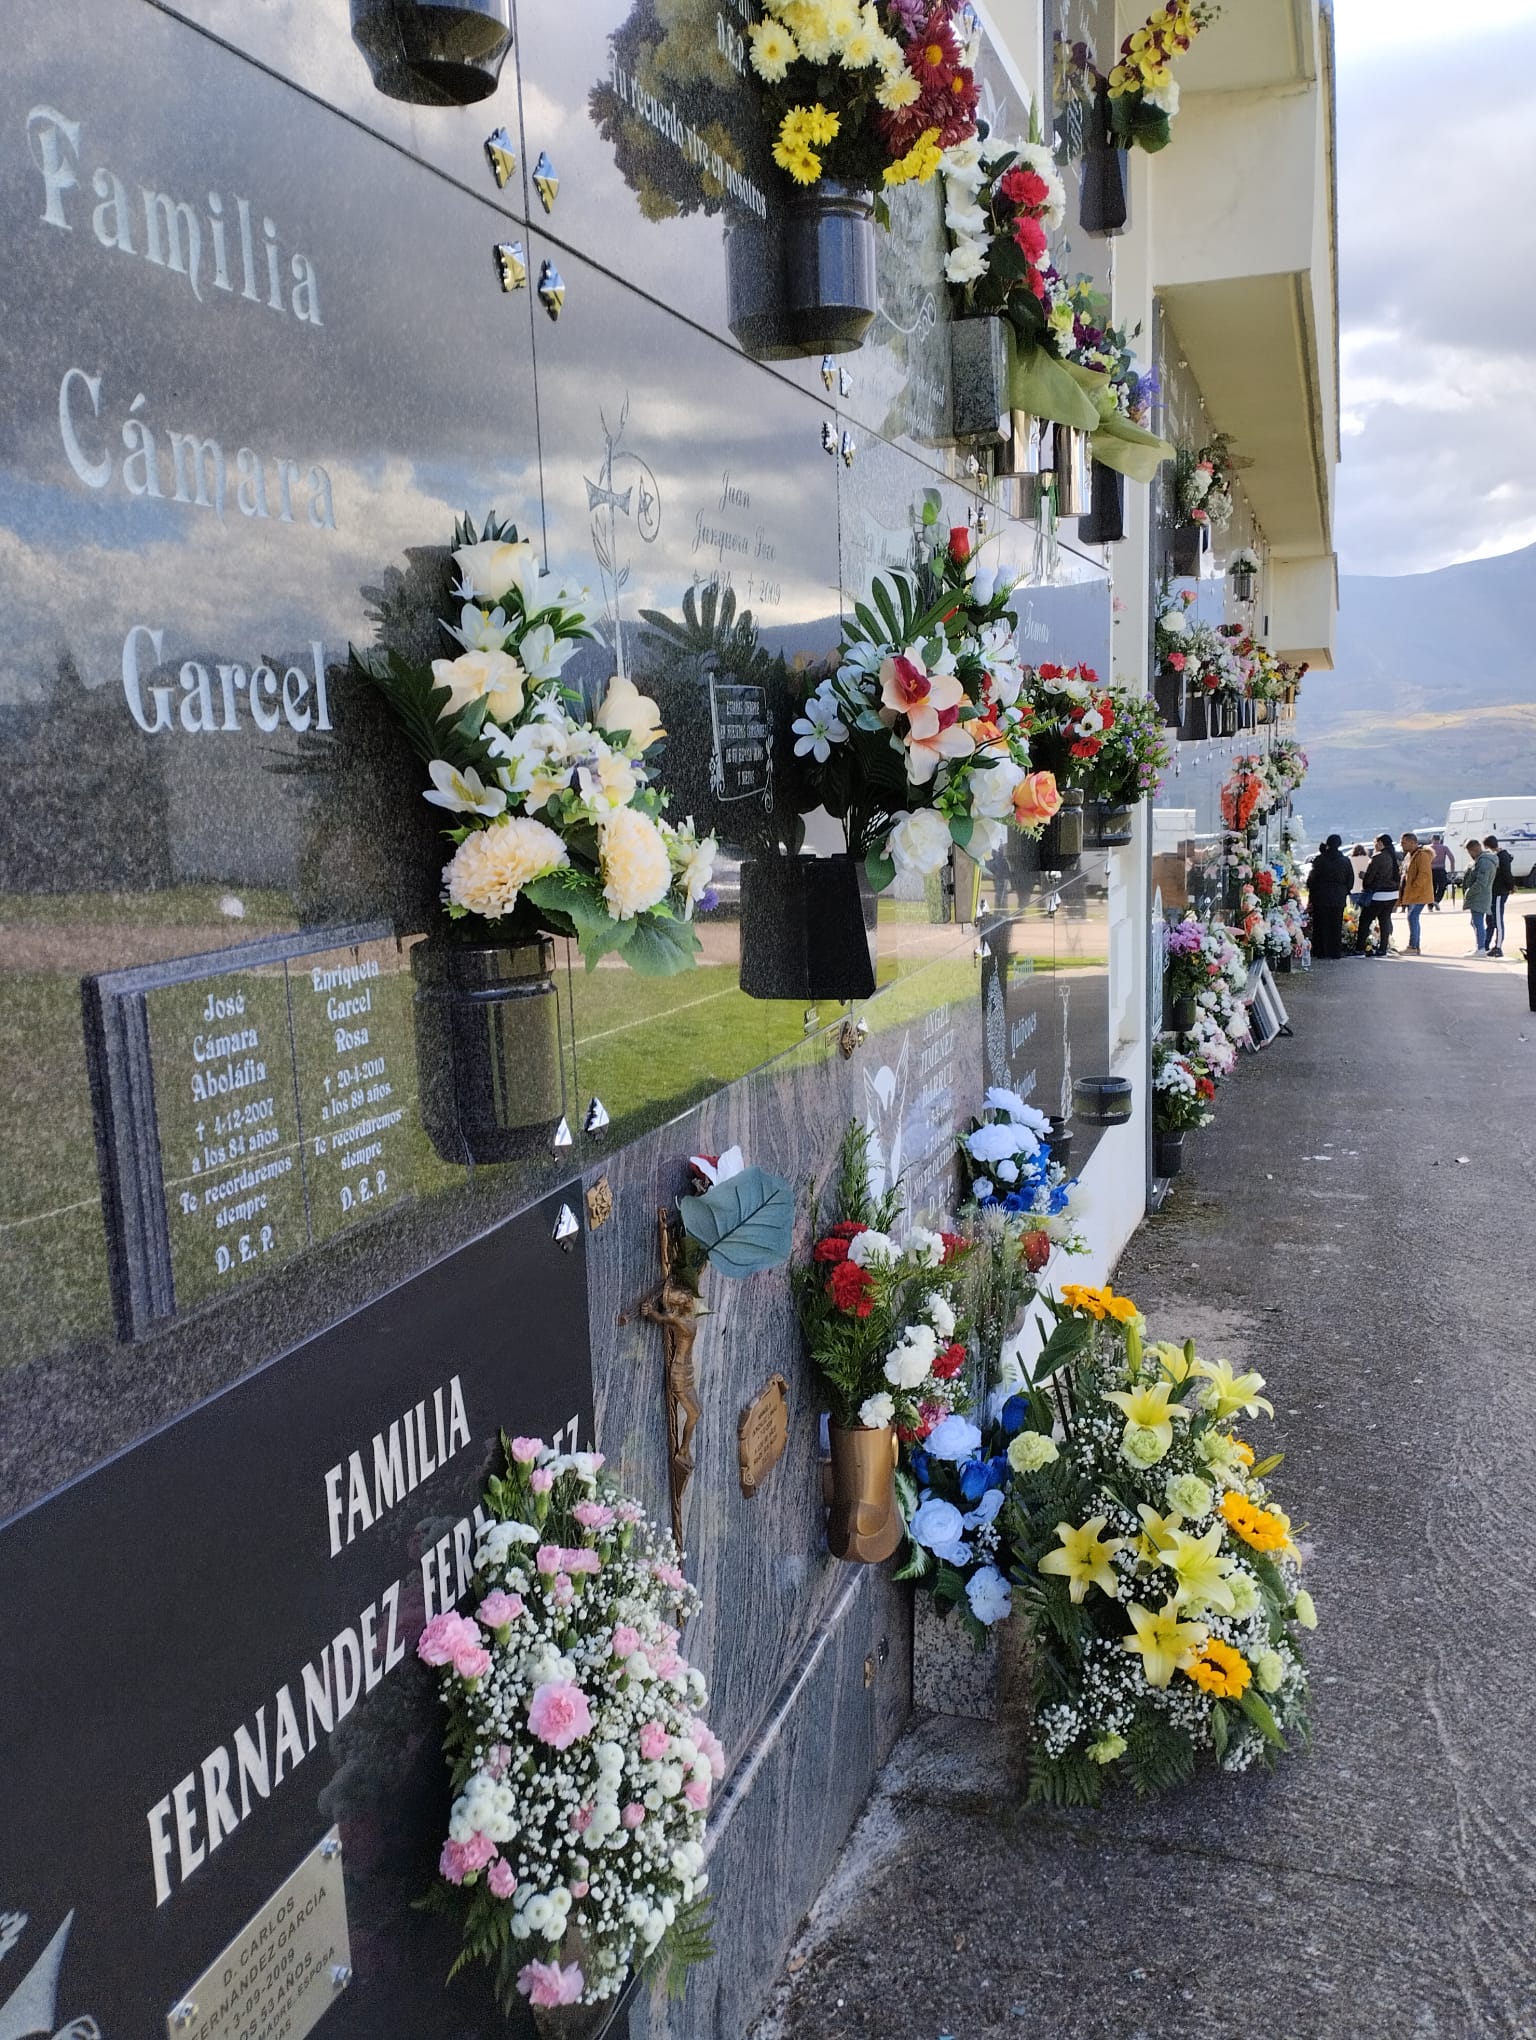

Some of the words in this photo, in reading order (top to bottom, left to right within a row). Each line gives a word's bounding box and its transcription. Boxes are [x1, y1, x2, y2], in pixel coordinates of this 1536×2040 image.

[611, 48, 628, 102] Tu
[631, 75, 684, 149] recuerdo
[685, 123, 709, 171] vive
[711, 150, 724, 191] en
[726, 161, 767, 220] nosotros
[26, 104, 323, 326] Familia
[58, 367, 338, 532] Cámara
[718, 470, 751, 513] Juan
[121, 623, 334, 735] Garcel
[311, 959, 379, 993] Enriqueta
[203, 988, 245, 1022] José
[327, 987, 371, 1022] Garcel
[193, 1028, 258, 1063] Cámara
[335, 1027, 369, 1054] Rosa
[191, 1058, 267, 1103] Aboláfia
[337, 1056, 385, 1089] 20-4-2010
[214, 1097, 274, 1136] 4-12-2007
[322, 1105, 330, 1121] a
[331, 1097, 349, 1117] los
[351, 1088, 365, 1110] 89
[366, 1081, 392, 1104] años
[192, 1156, 201, 1174] a
[204, 1146, 226, 1170] los
[229, 1135, 246, 1159] 84
[249, 1127, 280, 1151] años
[314, 1136, 327, 1156] Te
[332, 1109, 402, 1150] recordaremos
[341, 1141, 383, 1171] siempre
[179, 1191, 199, 1215] Te
[205, 1156, 293, 1206] recordaremos
[215, 1193, 268, 1230] siempre
[324, 1374, 472, 1558] FAMILIA
[146, 1578, 406, 1908] FERNANDEZ
[223, 1967, 237, 1987] D.
[240, 1896, 295, 1967] CARLOS
[298, 1946, 334, 1996] ESPOSA
[261, 1997, 275, 2023] 53
